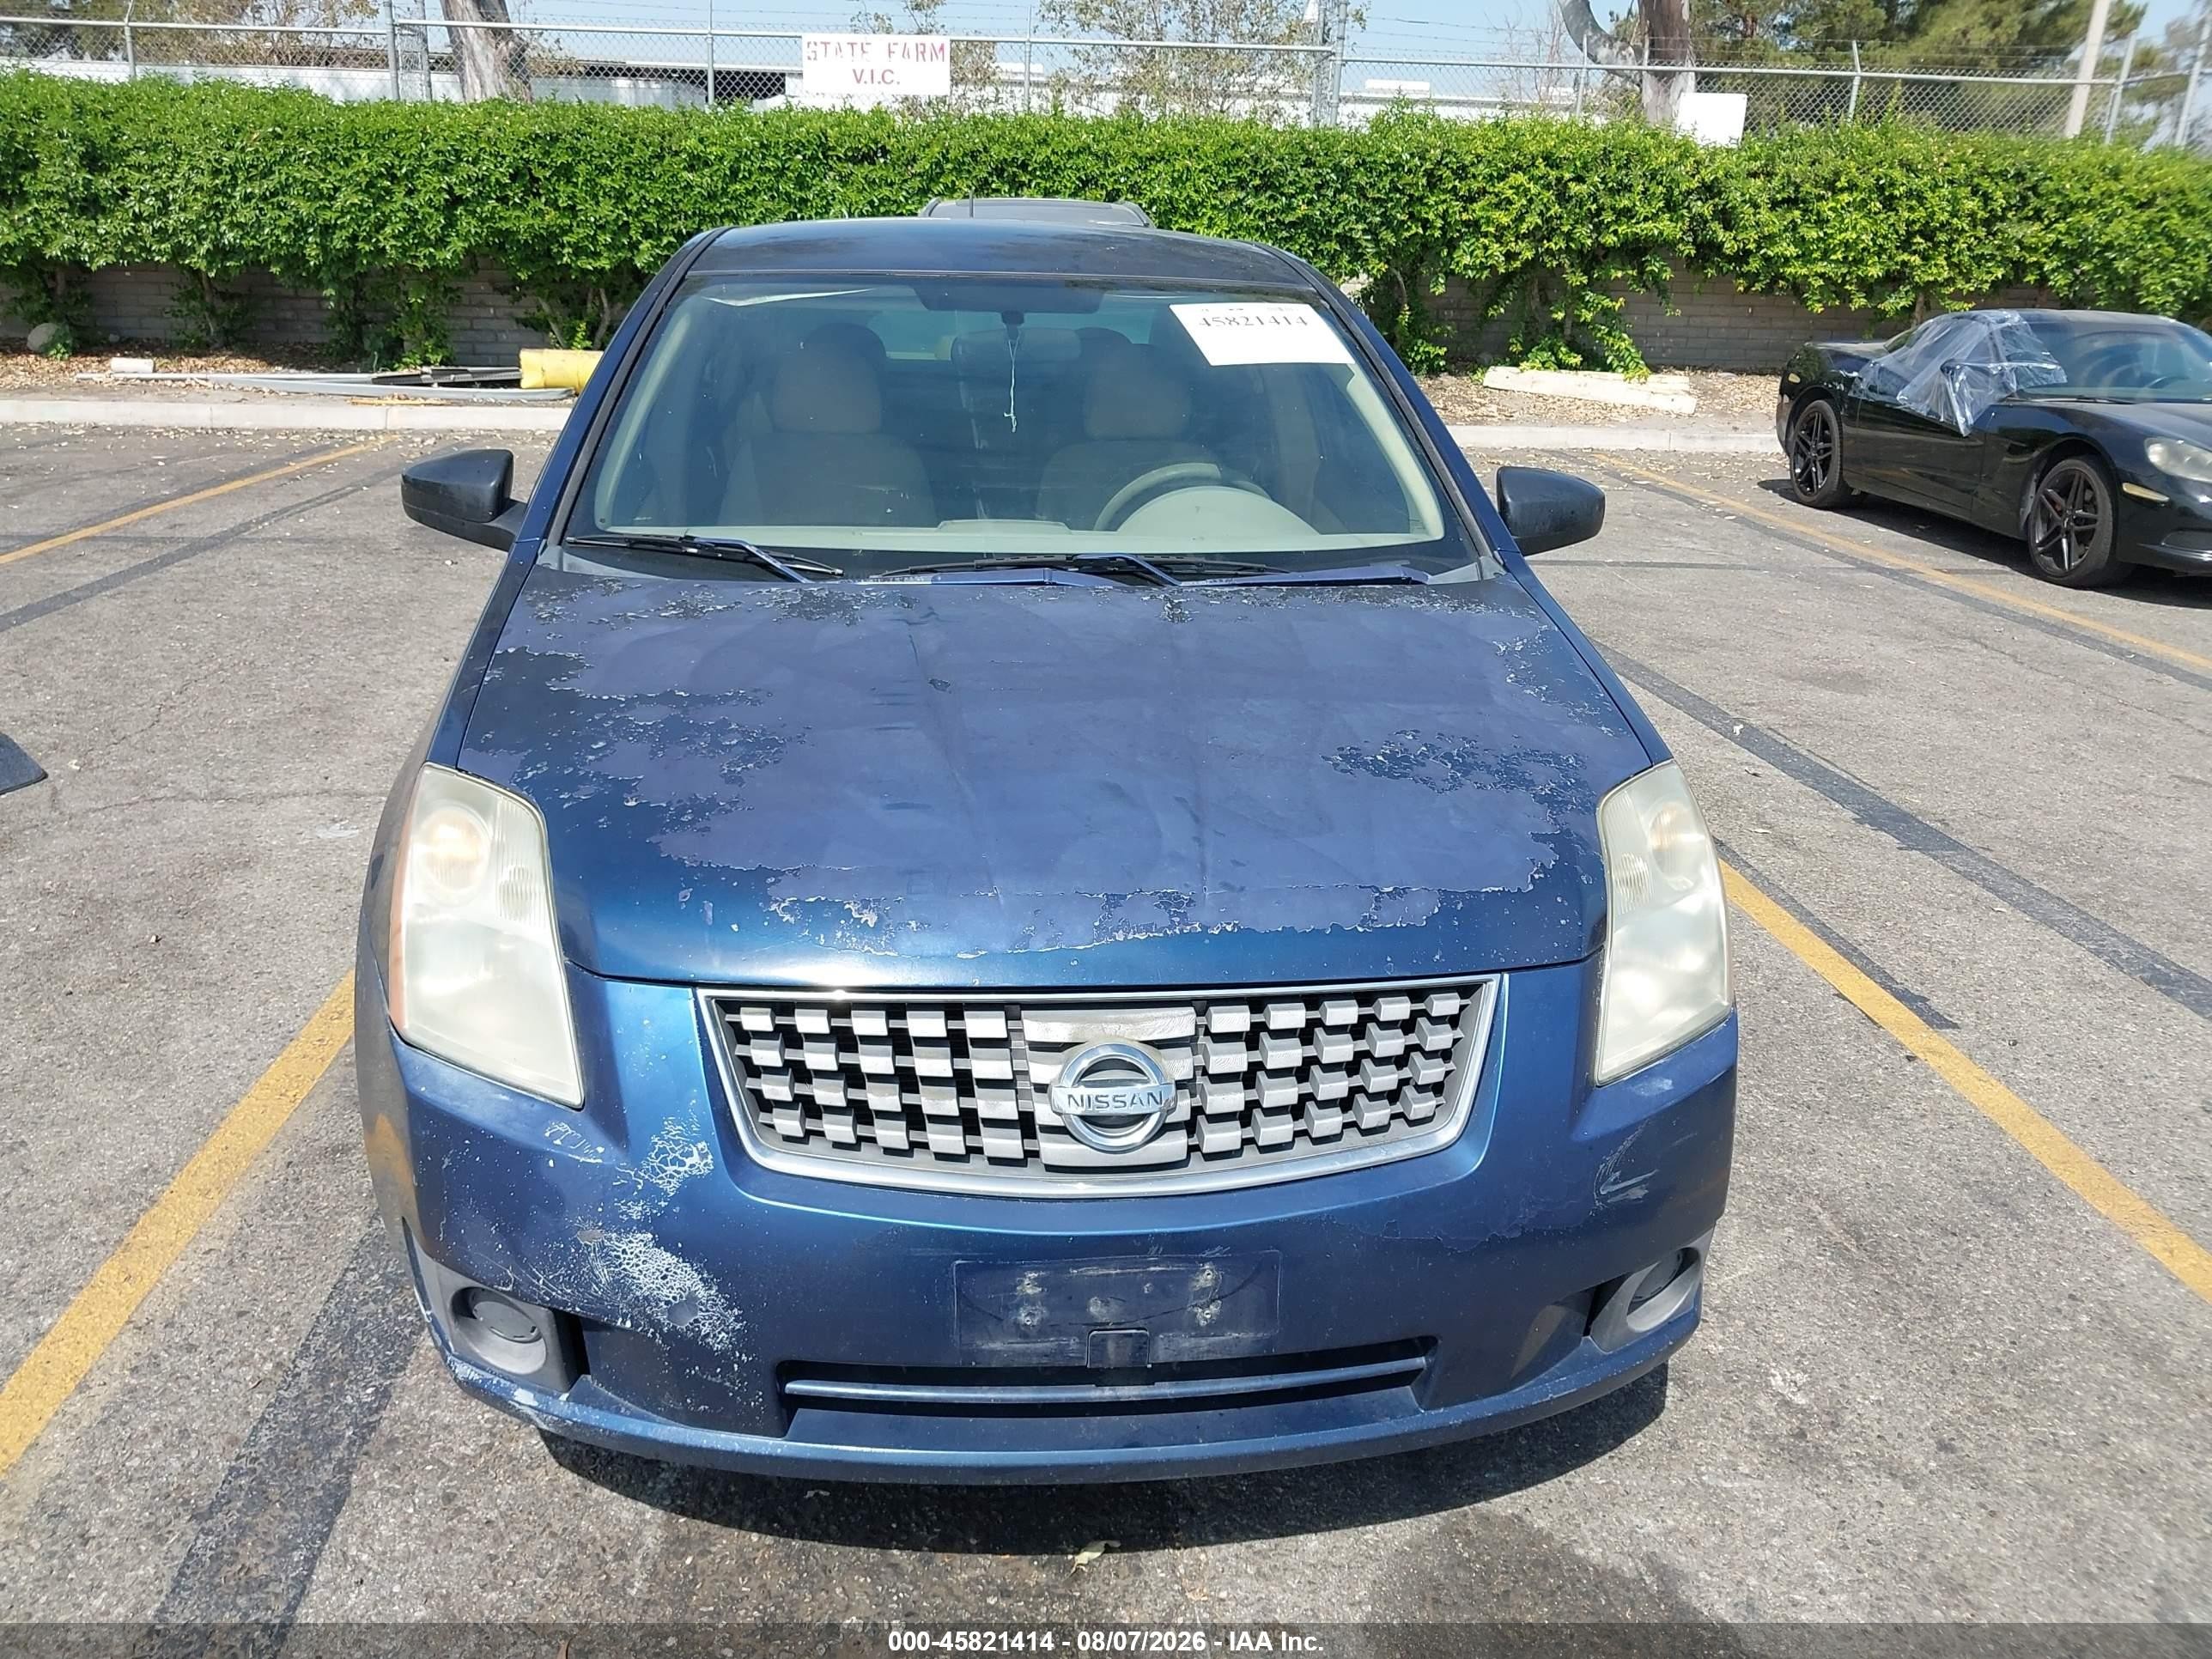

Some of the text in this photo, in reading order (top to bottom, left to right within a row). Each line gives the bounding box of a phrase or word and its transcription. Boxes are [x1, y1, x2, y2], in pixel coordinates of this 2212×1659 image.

[806, 41, 945, 63] STATE FARM
[852, 68, 901, 85] V.I.C.
[1199, 315, 1308, 327] 45821414
[1066, 1091, 1164, 1110] NISSAN
